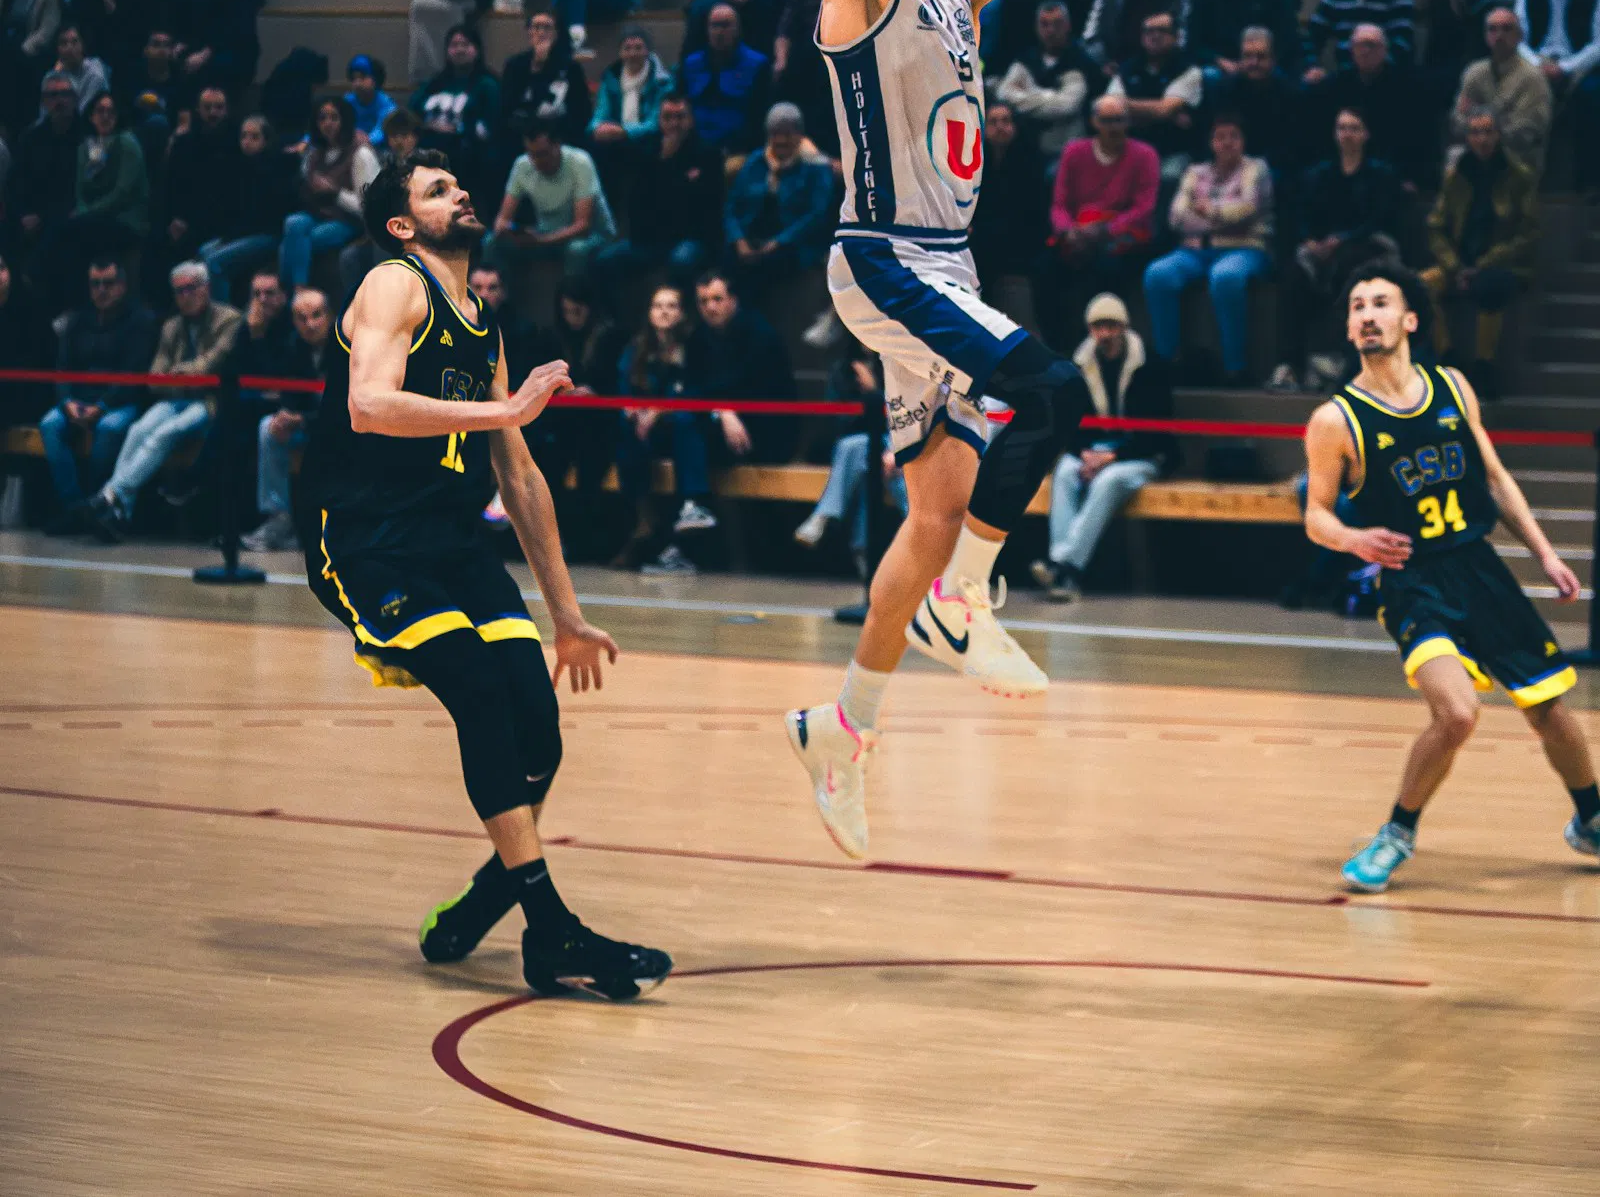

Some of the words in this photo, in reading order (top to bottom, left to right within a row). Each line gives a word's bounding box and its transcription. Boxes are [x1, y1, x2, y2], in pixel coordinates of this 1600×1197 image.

[946, 119, 981, 181] U
[1390, 441, 1466, 496] CSB
[1416, 488, 1468, 539] 34
